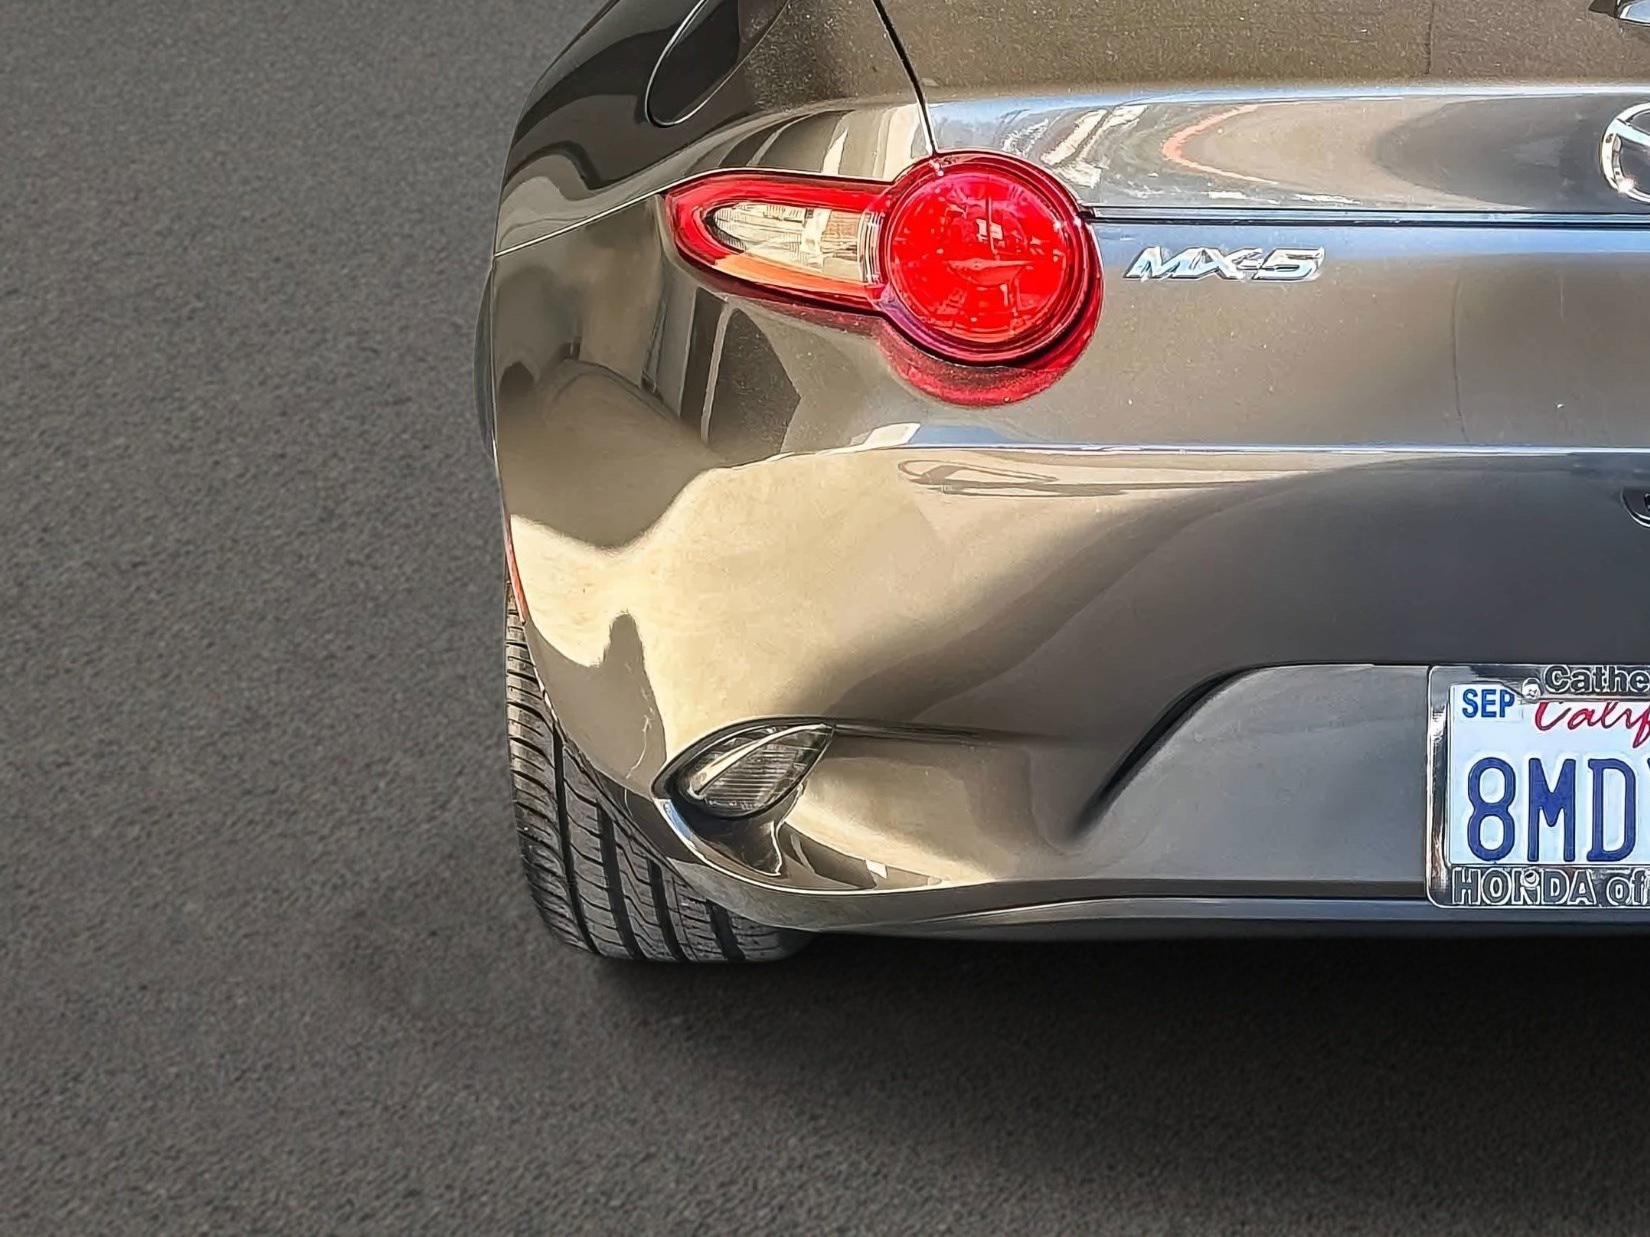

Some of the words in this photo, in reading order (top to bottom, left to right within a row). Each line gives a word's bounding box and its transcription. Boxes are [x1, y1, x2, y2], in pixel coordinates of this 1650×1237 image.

[1123, 246, 1326, 282] MX-5
[1461, 689, 1515, 718] SEP
[1452, 869, 1596, 905] HONDA
[1605, 869, 1644, 905] of
